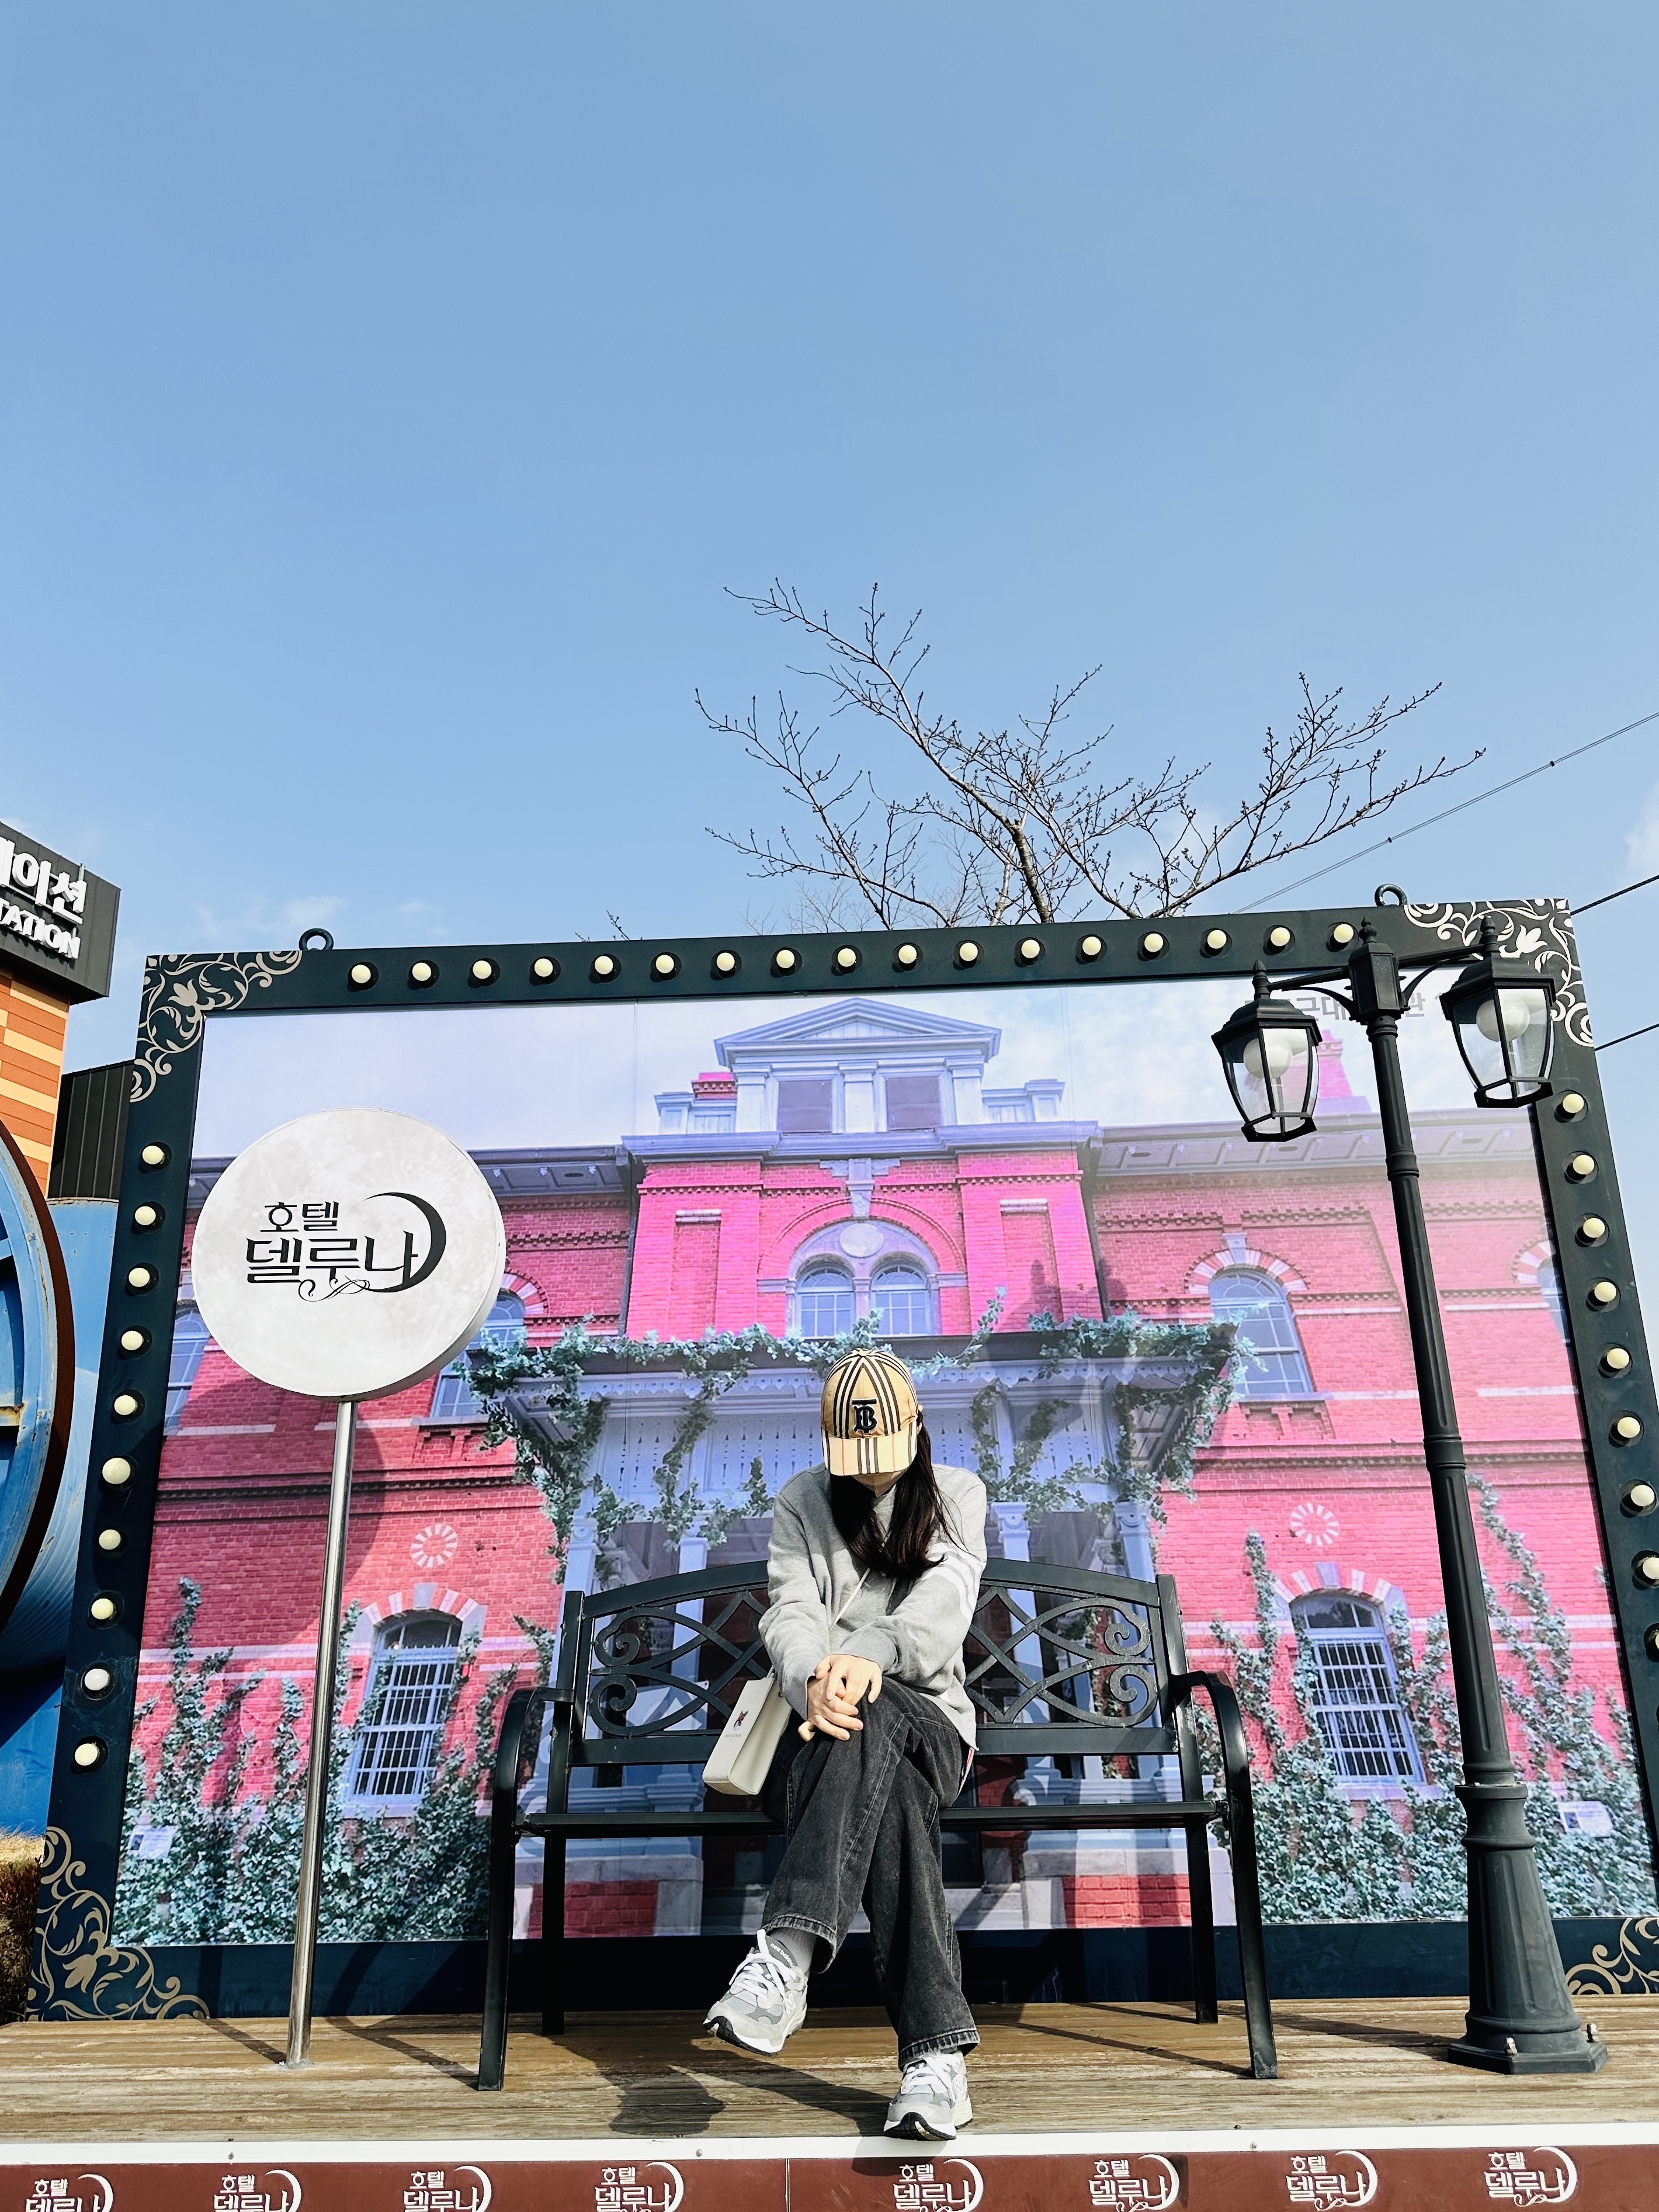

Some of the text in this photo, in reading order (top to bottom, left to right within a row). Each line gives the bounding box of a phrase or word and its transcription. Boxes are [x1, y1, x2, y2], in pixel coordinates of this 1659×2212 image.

[0, 836, 87, 924] 이션
[261, 1201, 339, 1232] 호텔
[245, 1230, 419, 1287] 델루나
[770, 1943, 782, 1952] new
[1094, 2159, 1130, 2178] 호텔
[1290, 2155, 1327, 2173] 호텔
[1488, 2152, 1526, 2170] 호텔
[220, 2175, 255, 2193] 호텔
[409, 2171, 445, 2189] 호텔
[601, 2166, 636, 2185] 호텔
[899, 2164, 934, 2182] 호텔
[1484, 2167, 1566, 2200] 델루나
[32, 2178, 68, 2197] 호텔
[595, 2182, 672, 2212] 델루나
[893, 2179, 972, 2211] 델루나
[1088, 2175, 1168, 2207] 델루나
[1285, 2171, 1366, 2203] 델루나
[404, 2186, 480, 2212] 델루나
